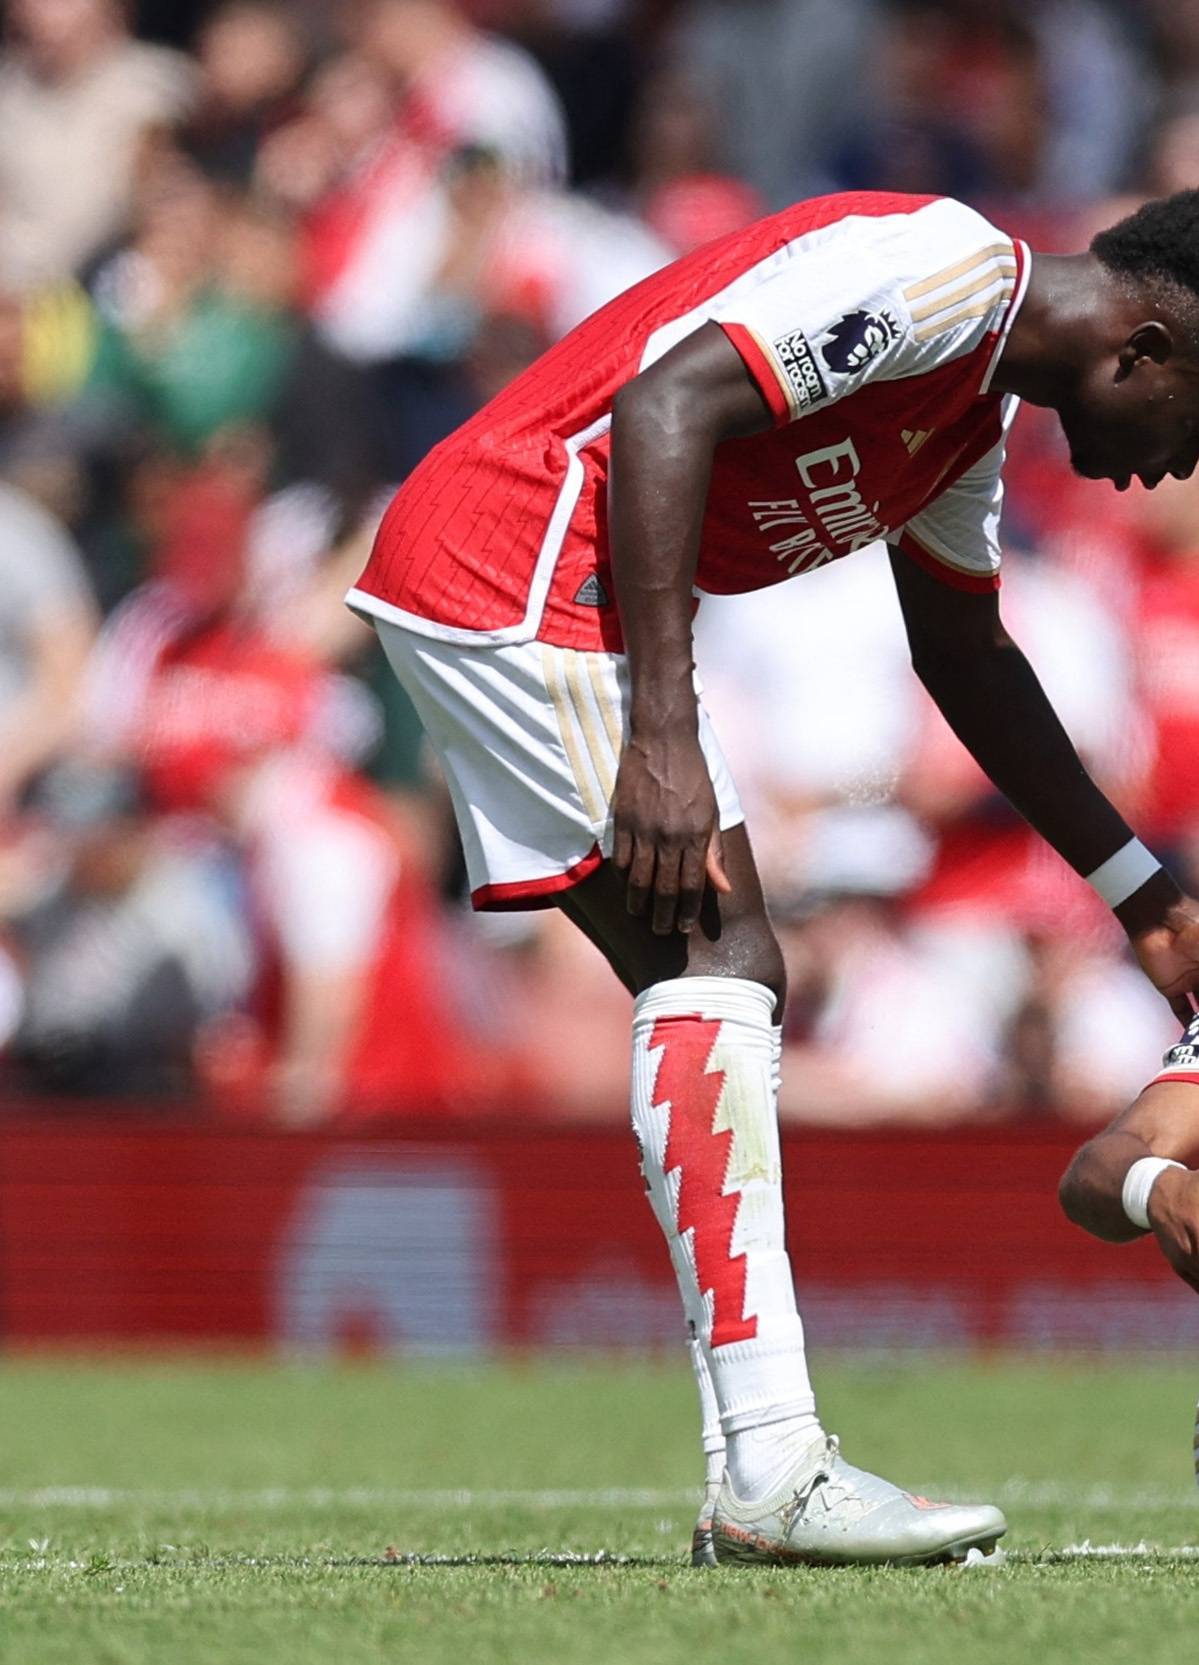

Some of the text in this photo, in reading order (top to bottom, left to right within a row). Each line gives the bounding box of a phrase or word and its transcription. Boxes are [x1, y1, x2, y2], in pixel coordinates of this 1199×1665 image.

[774, 338, 795, 361] for
[788, 329, 822, 399] No room
